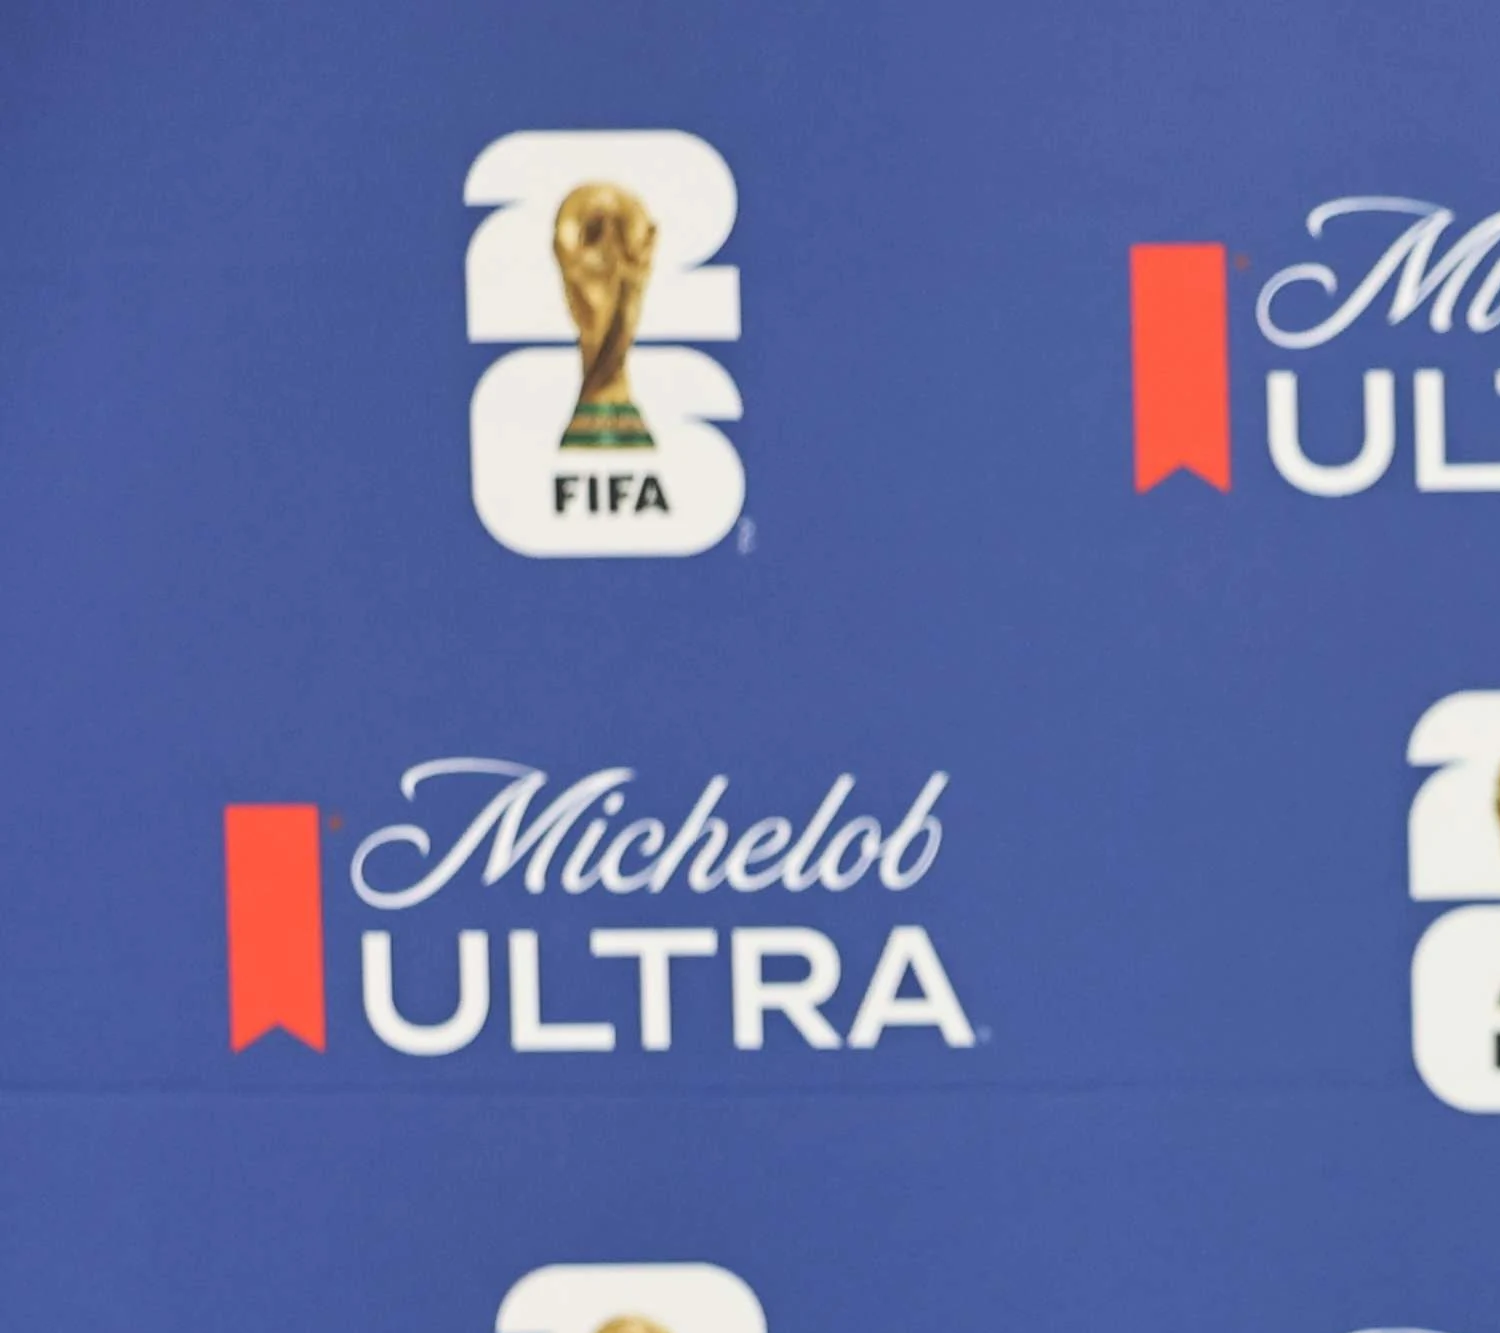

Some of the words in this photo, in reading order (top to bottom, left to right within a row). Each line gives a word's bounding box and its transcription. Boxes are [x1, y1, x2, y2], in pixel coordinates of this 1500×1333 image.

[555, 476, 670, 514] FIFA
[351, 758, 948, 909] Michelob
[362, 926, 975, 1056] ULTRA
